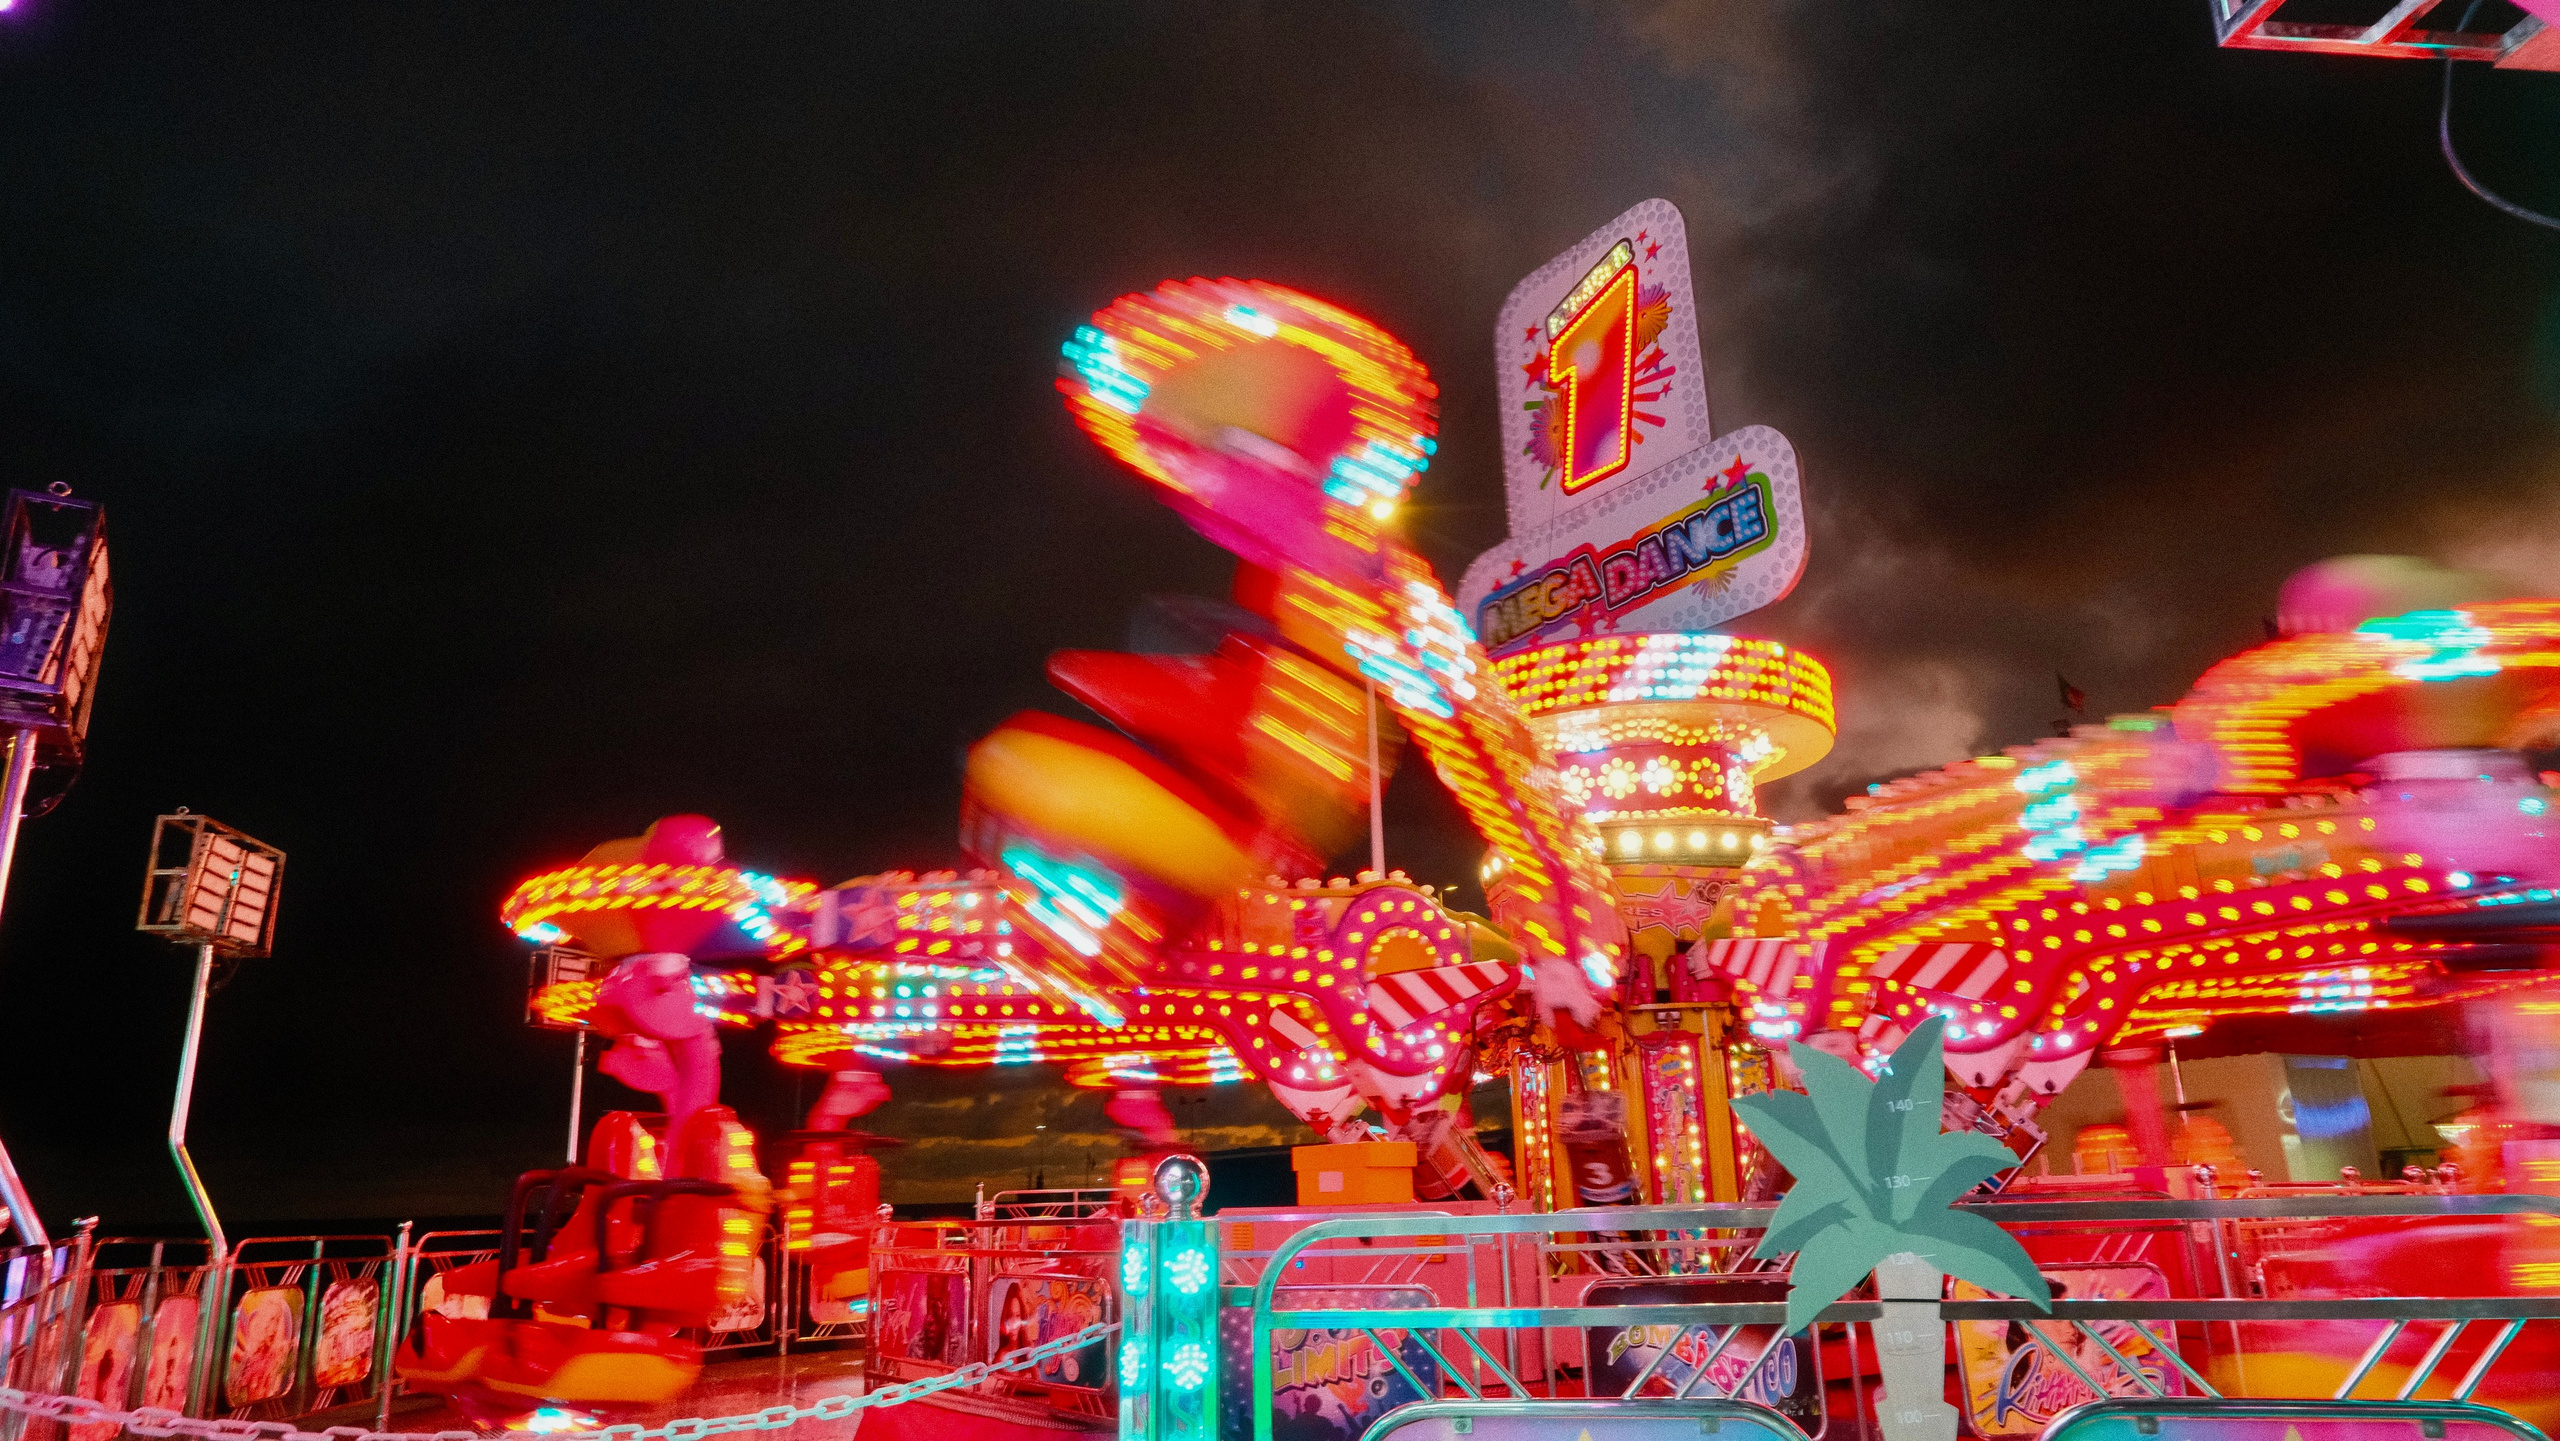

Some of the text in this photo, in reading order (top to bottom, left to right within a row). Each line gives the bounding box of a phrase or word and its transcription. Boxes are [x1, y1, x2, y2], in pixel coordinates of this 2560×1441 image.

[1549, 264, 1638, 495] 1
[1484, 489, 1763, 651] MEGA DANCE
[1886, 1098, 1914, 1113] 140
[1583, 1162, 1614, 1186] 3
[1884, 1174, 1911, 1189] 130
[1273, 1330, 1402, 1391] LIMITS
